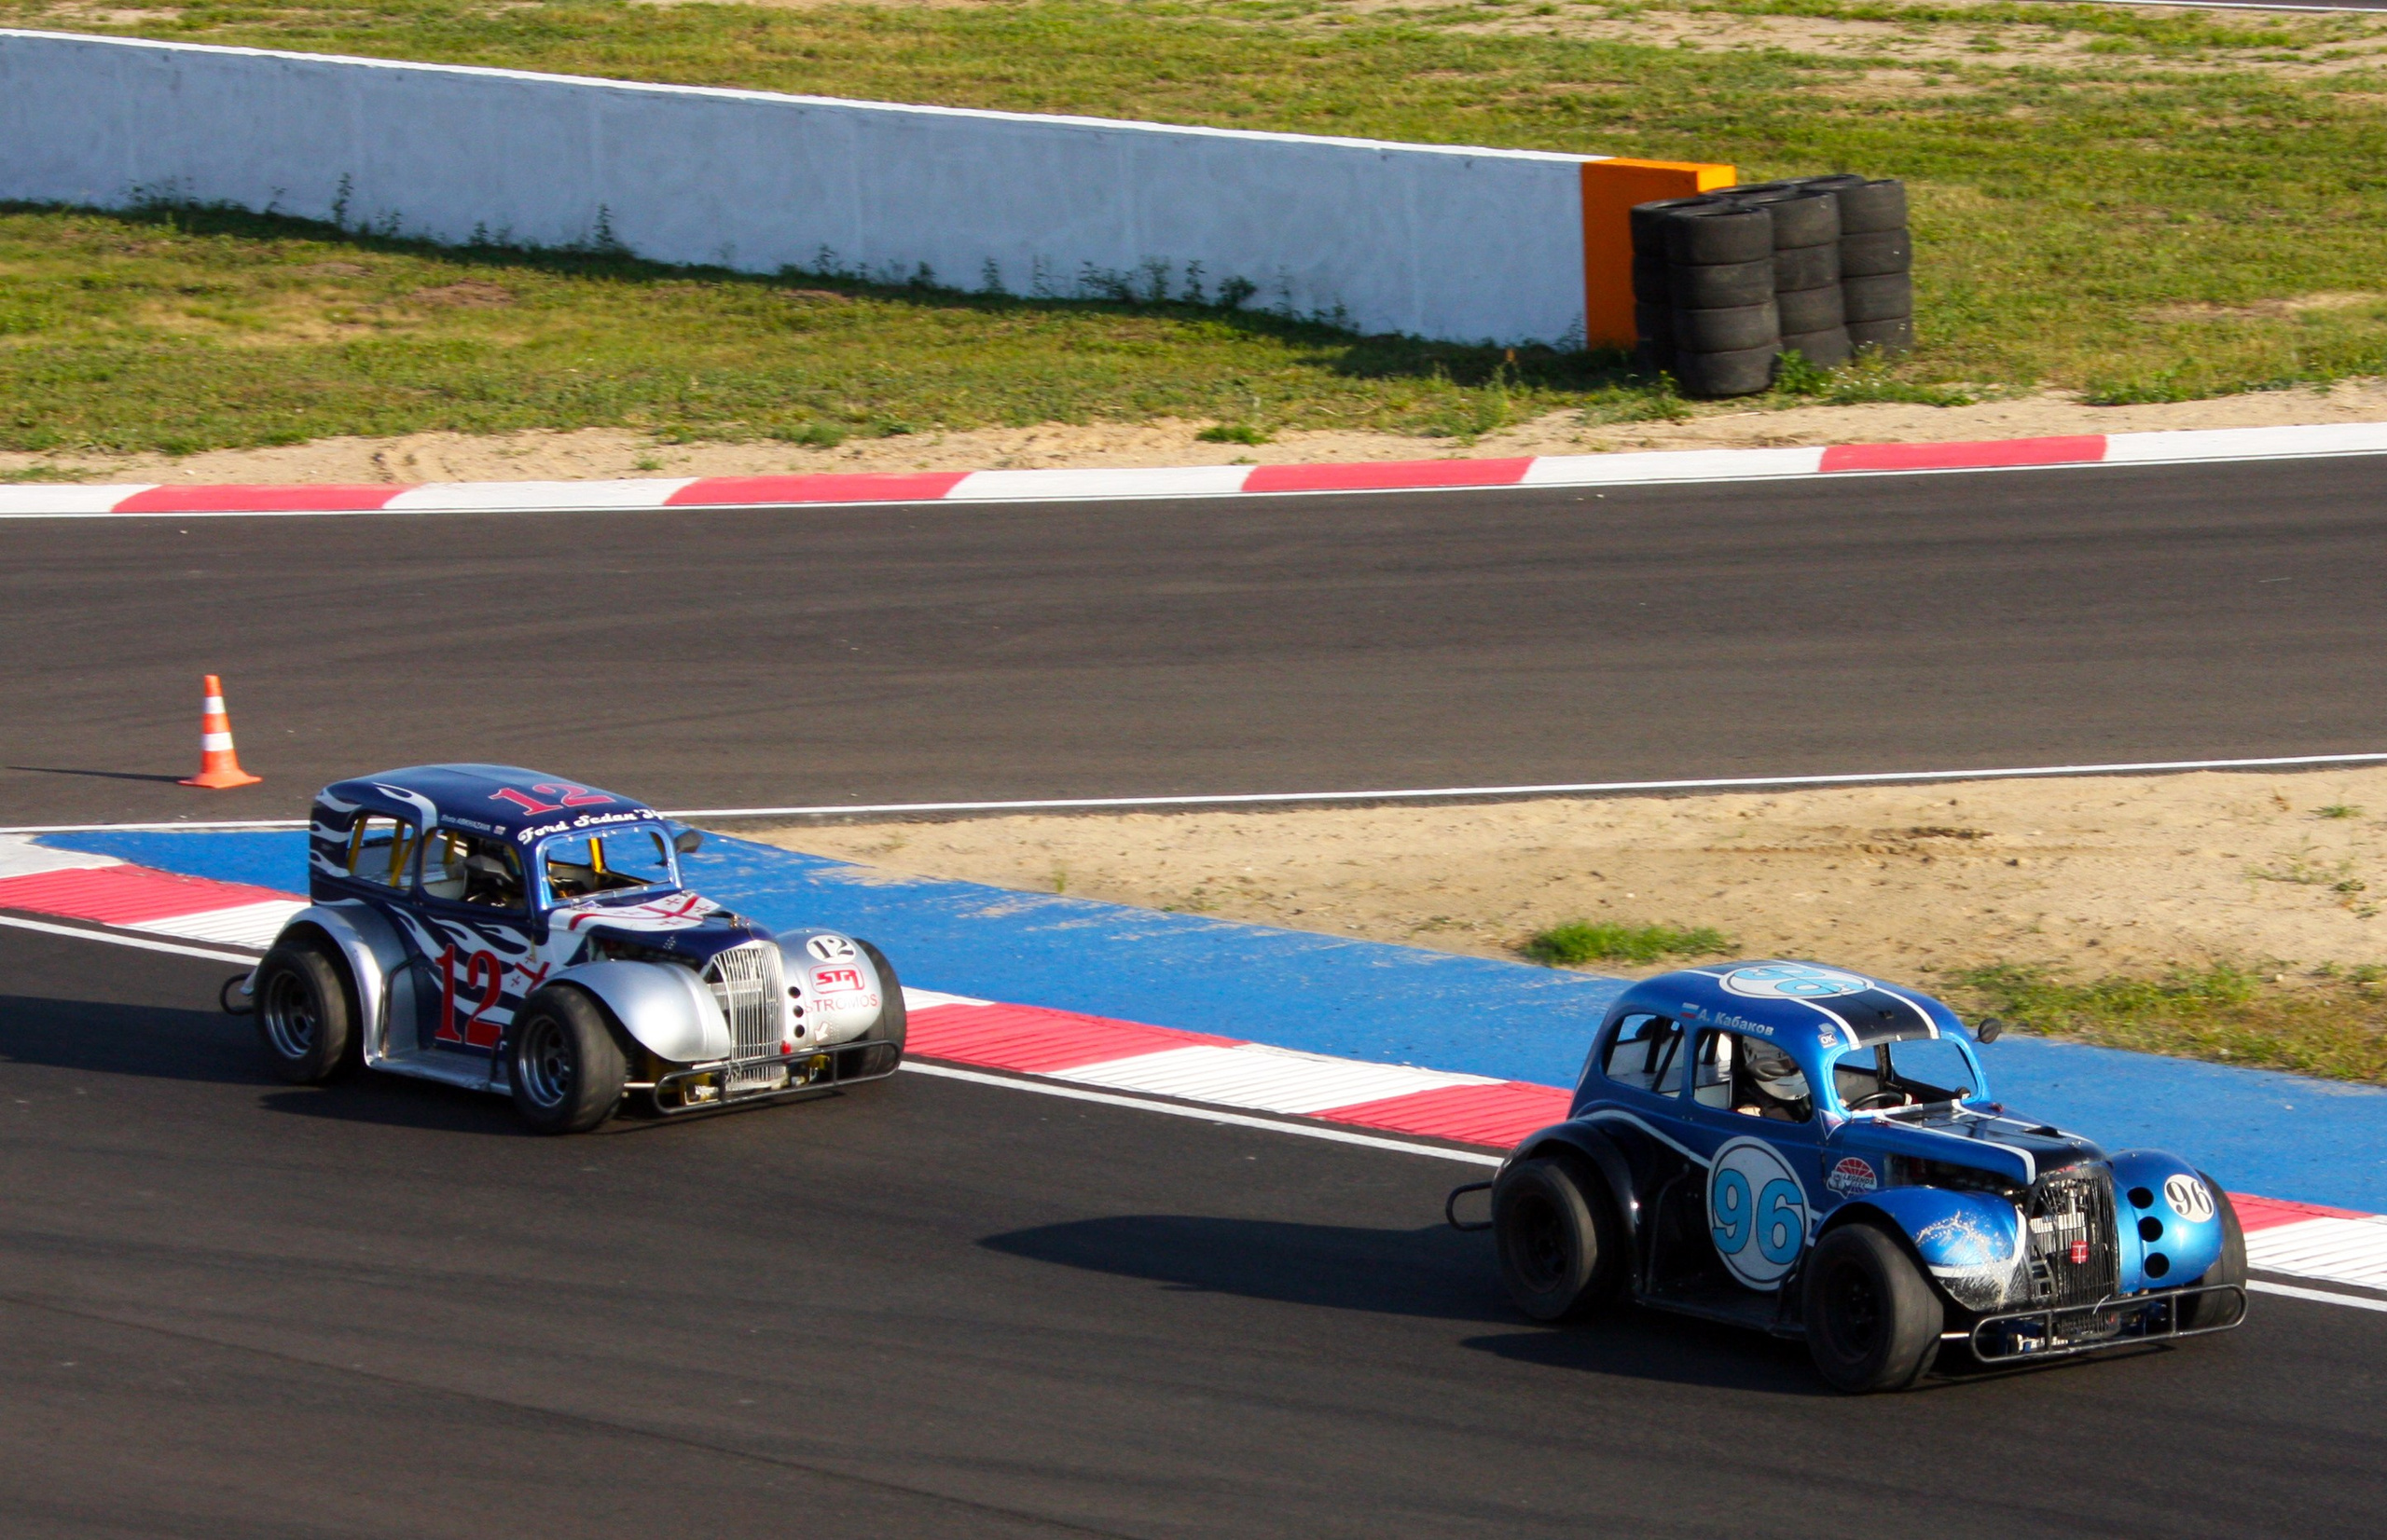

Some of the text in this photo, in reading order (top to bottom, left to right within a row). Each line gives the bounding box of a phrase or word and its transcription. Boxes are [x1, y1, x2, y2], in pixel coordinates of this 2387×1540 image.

[488, 782, 616, 817] 12
[517, 820, 570, 845] Ford
[808, 936, 855, 960] 12
[434, 942, 504, 1051] 12
[804, 993, 878, 1014] STROMOS
[1714, 1011, 1774, 1037] Кабаков
[1820, 1033, 1836, 1045] OK
[2165, 1180, 2213, 1216] 96
[1711, 1168, 1806, 1265] 96
